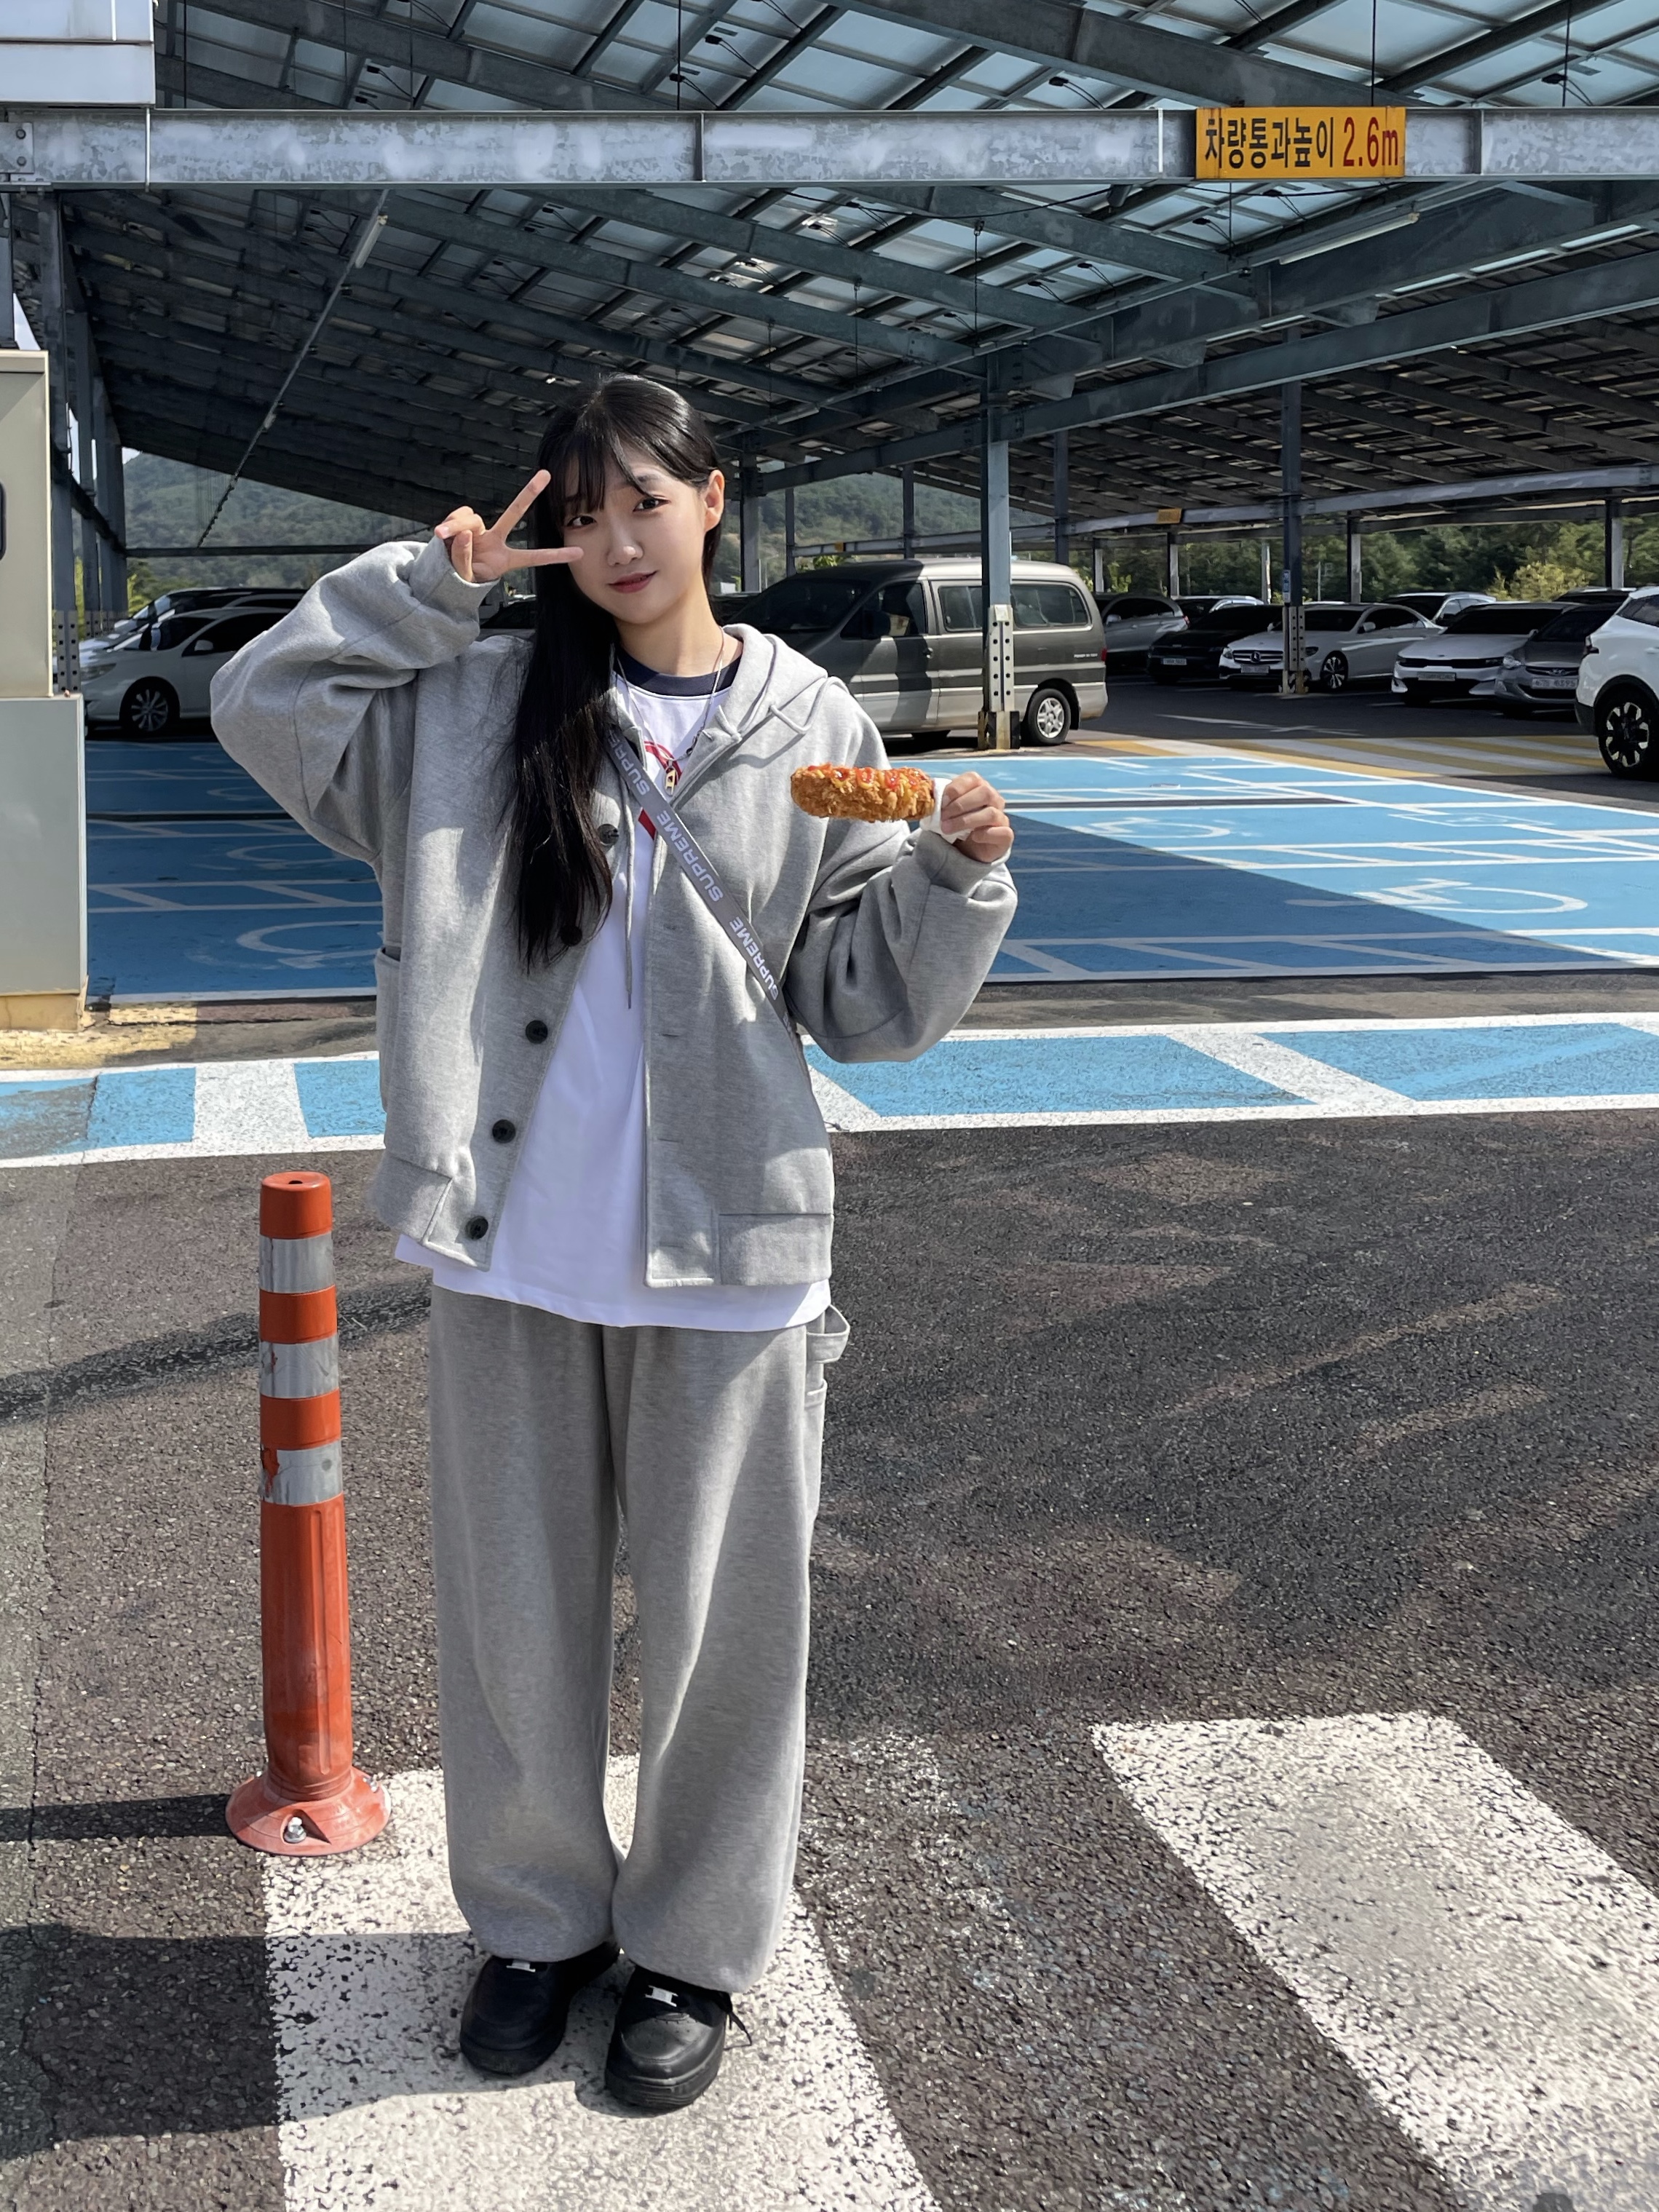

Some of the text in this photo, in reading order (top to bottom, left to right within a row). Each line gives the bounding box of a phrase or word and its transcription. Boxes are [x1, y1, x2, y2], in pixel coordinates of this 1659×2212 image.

[1205, 116, 1398, 169] 차량통과높이 2.6m
[657, 810, 724, 902] SUPREME
[729, 916, 778, 1000] SUPREME
